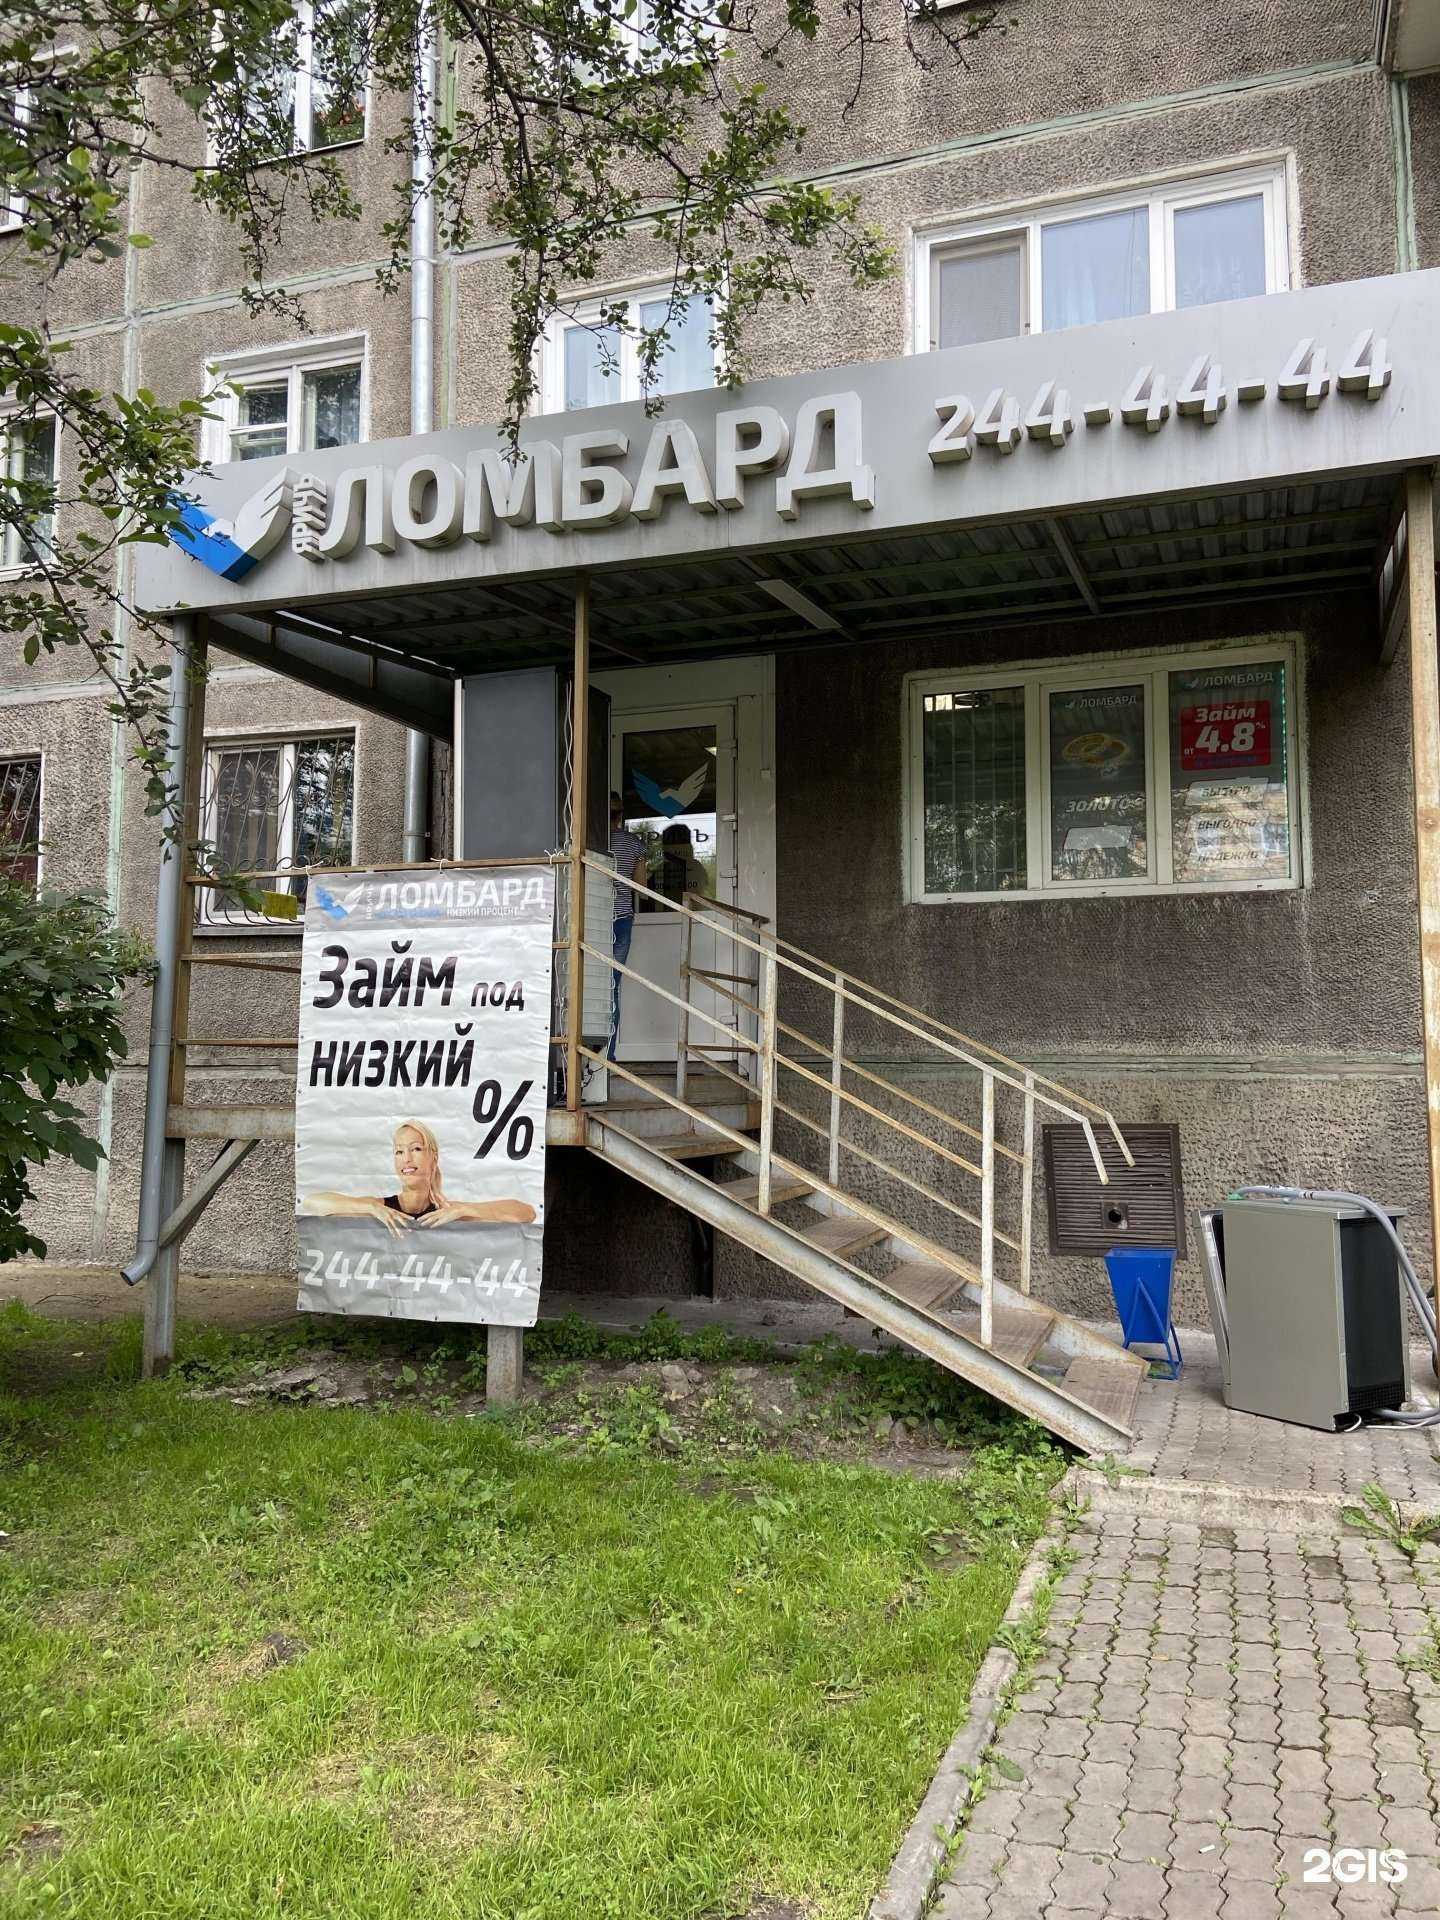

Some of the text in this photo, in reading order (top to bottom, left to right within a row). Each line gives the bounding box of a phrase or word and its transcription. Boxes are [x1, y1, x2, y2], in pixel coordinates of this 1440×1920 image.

[928, 328, 1392, 464] 244-44-44
[319, 391, 875, 558] ЛОМБАРД
[1081, 696, 1137, 709] ЛОМБАРД
[1204, 672, 1274, 686] ЛОМБАРД
[1195, 706, 1257, 723] Займ
[377, 877, 546, 909] ЛОМБАРД
[313, 940, 525, 1012] Займ под
[472, 1079, 535, 1161] %
[304, 1248, 529, 1298] 244-44-44
